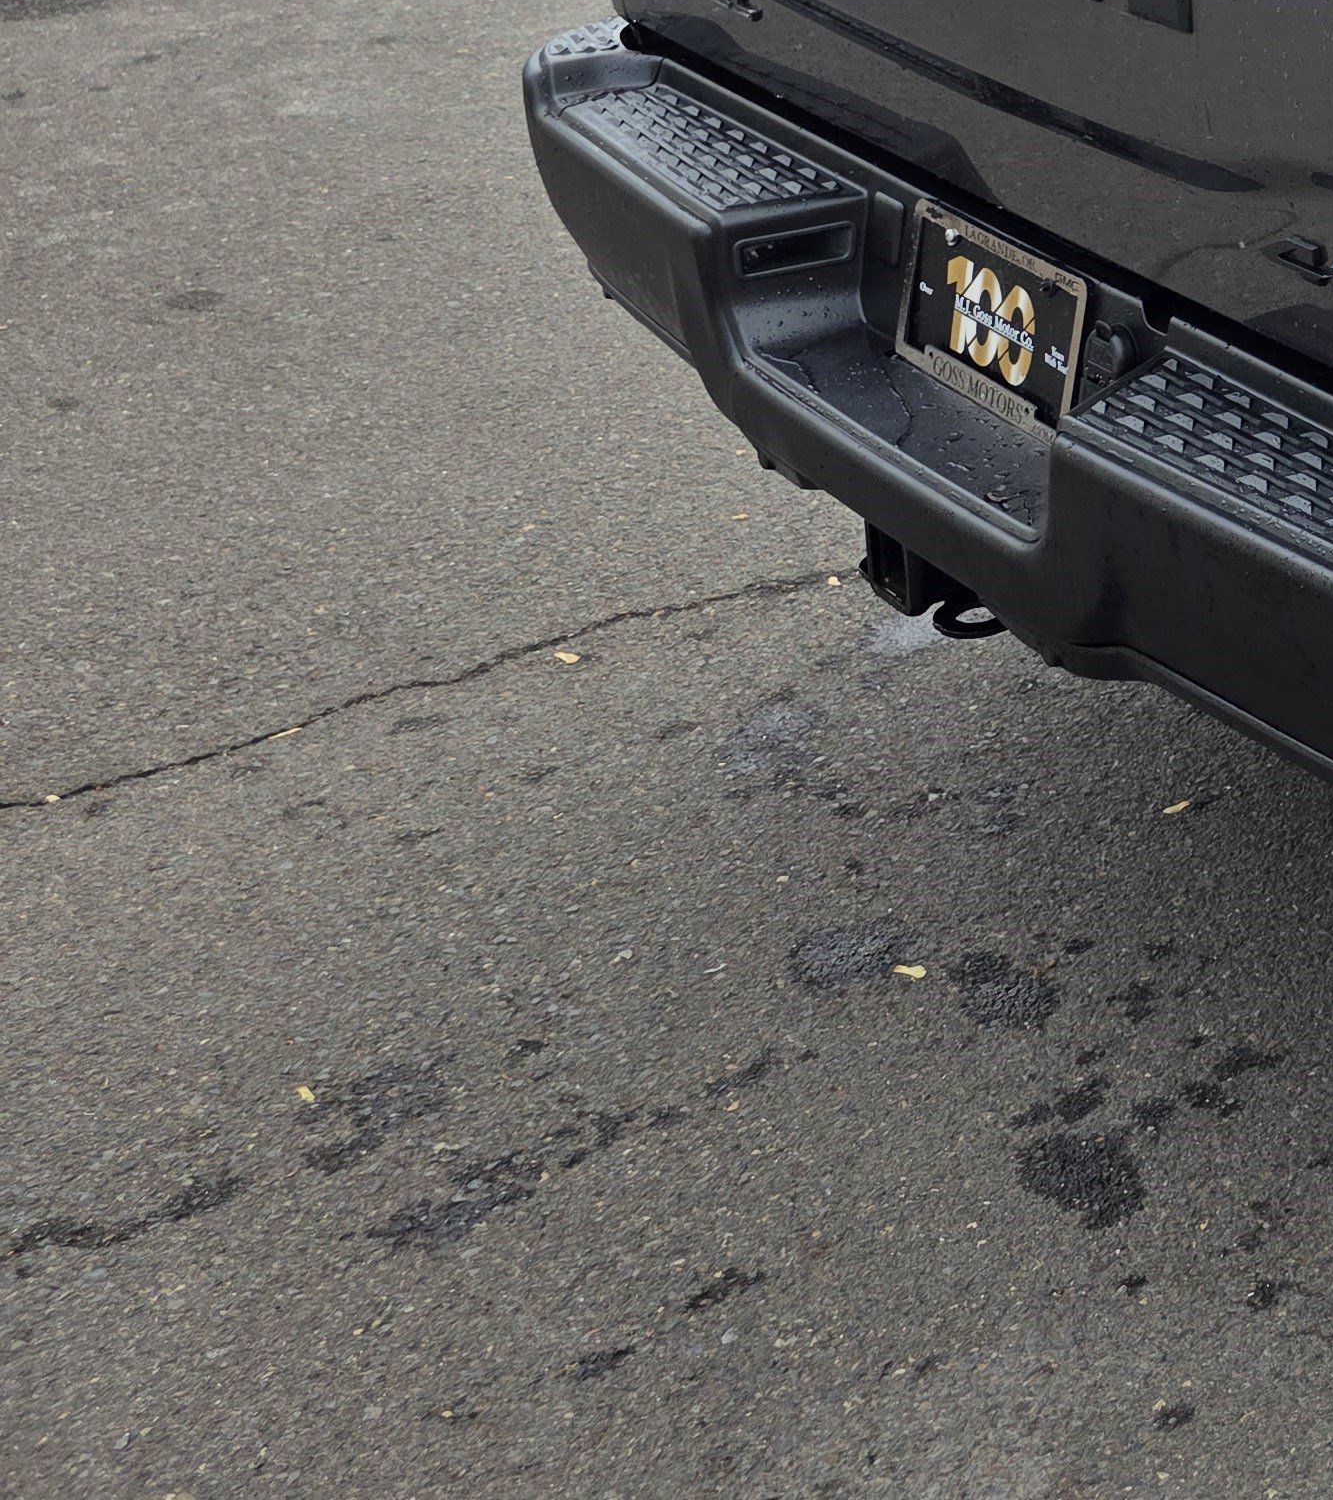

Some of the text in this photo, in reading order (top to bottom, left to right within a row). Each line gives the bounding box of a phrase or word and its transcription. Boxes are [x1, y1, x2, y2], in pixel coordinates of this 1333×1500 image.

[1055, 271, 1080, 292] GMC
[947, 255, 1036, 387] 100
[973, 304, 993, 326] Goss
[994, 315, 1020, 342] Motor
